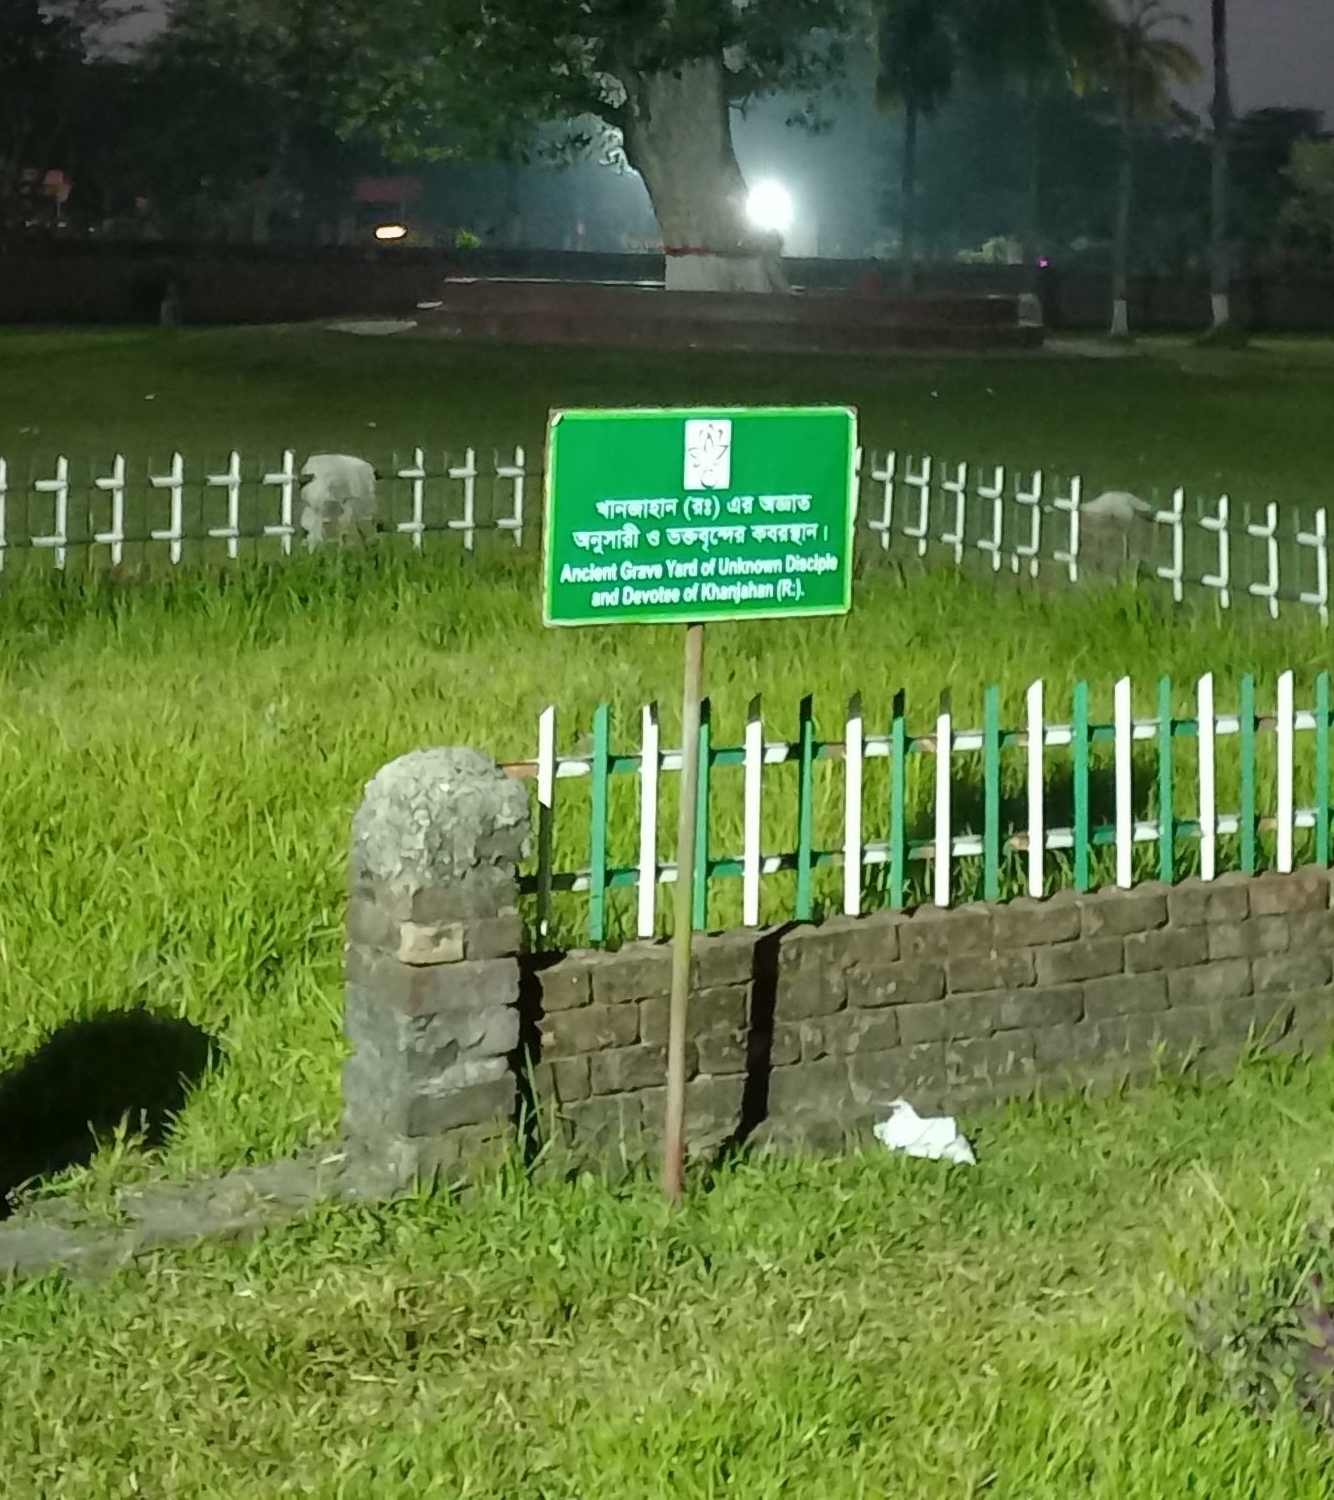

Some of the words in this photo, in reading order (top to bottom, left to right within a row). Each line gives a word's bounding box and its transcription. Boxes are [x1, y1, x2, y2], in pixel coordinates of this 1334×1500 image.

[596, 498, 678, 520] খানজাহান
[727, 496, 753, 514] এর
[759, 494, 812, 513] অজ্ঞাত
[572, 523, 640, 555] অনুসারী
[646, 532, 661, 548] ও
[667, 526, 746, 552] ভক্তবৃন্দের
[752, 523, 818, 546] কবরস্থান
[560, 562, 617, 583] Ancient
[620, 561, 663, 579] Grave
[666, 558, 697, 578] Yard
[701, 557, 716, 576] of
[718, 556, 782, 575] Unknown
[785, 553, 838, 576] Disciple
[591, 587, 619, 607] and
[622, 585, 680, 605] Devotee
[683, 583, 699, 602] of
[701, 581, 774, 604] Khanjahan
